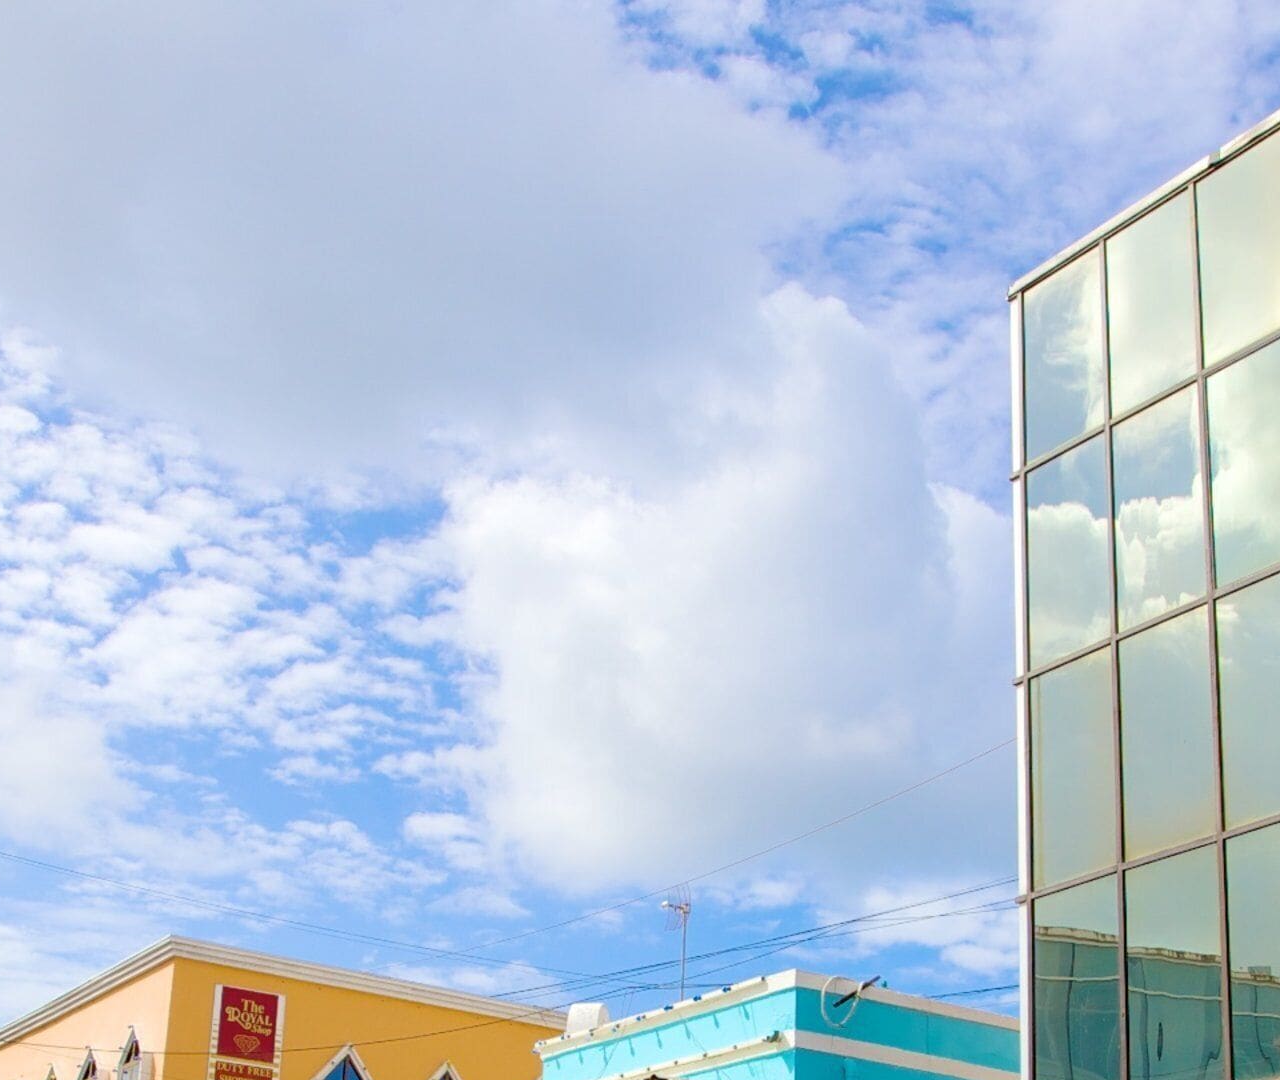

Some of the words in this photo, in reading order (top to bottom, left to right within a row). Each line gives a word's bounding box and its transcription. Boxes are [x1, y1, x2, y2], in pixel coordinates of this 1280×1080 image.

[240, 998, 265, 1014] The
[225, 1006, 273, 1030] ROYAL
[250, 1024, 273, 1037] Shop
[216, 1062, 244, 1074] DUTY
[247, 1066, 272, 1078] FREE
